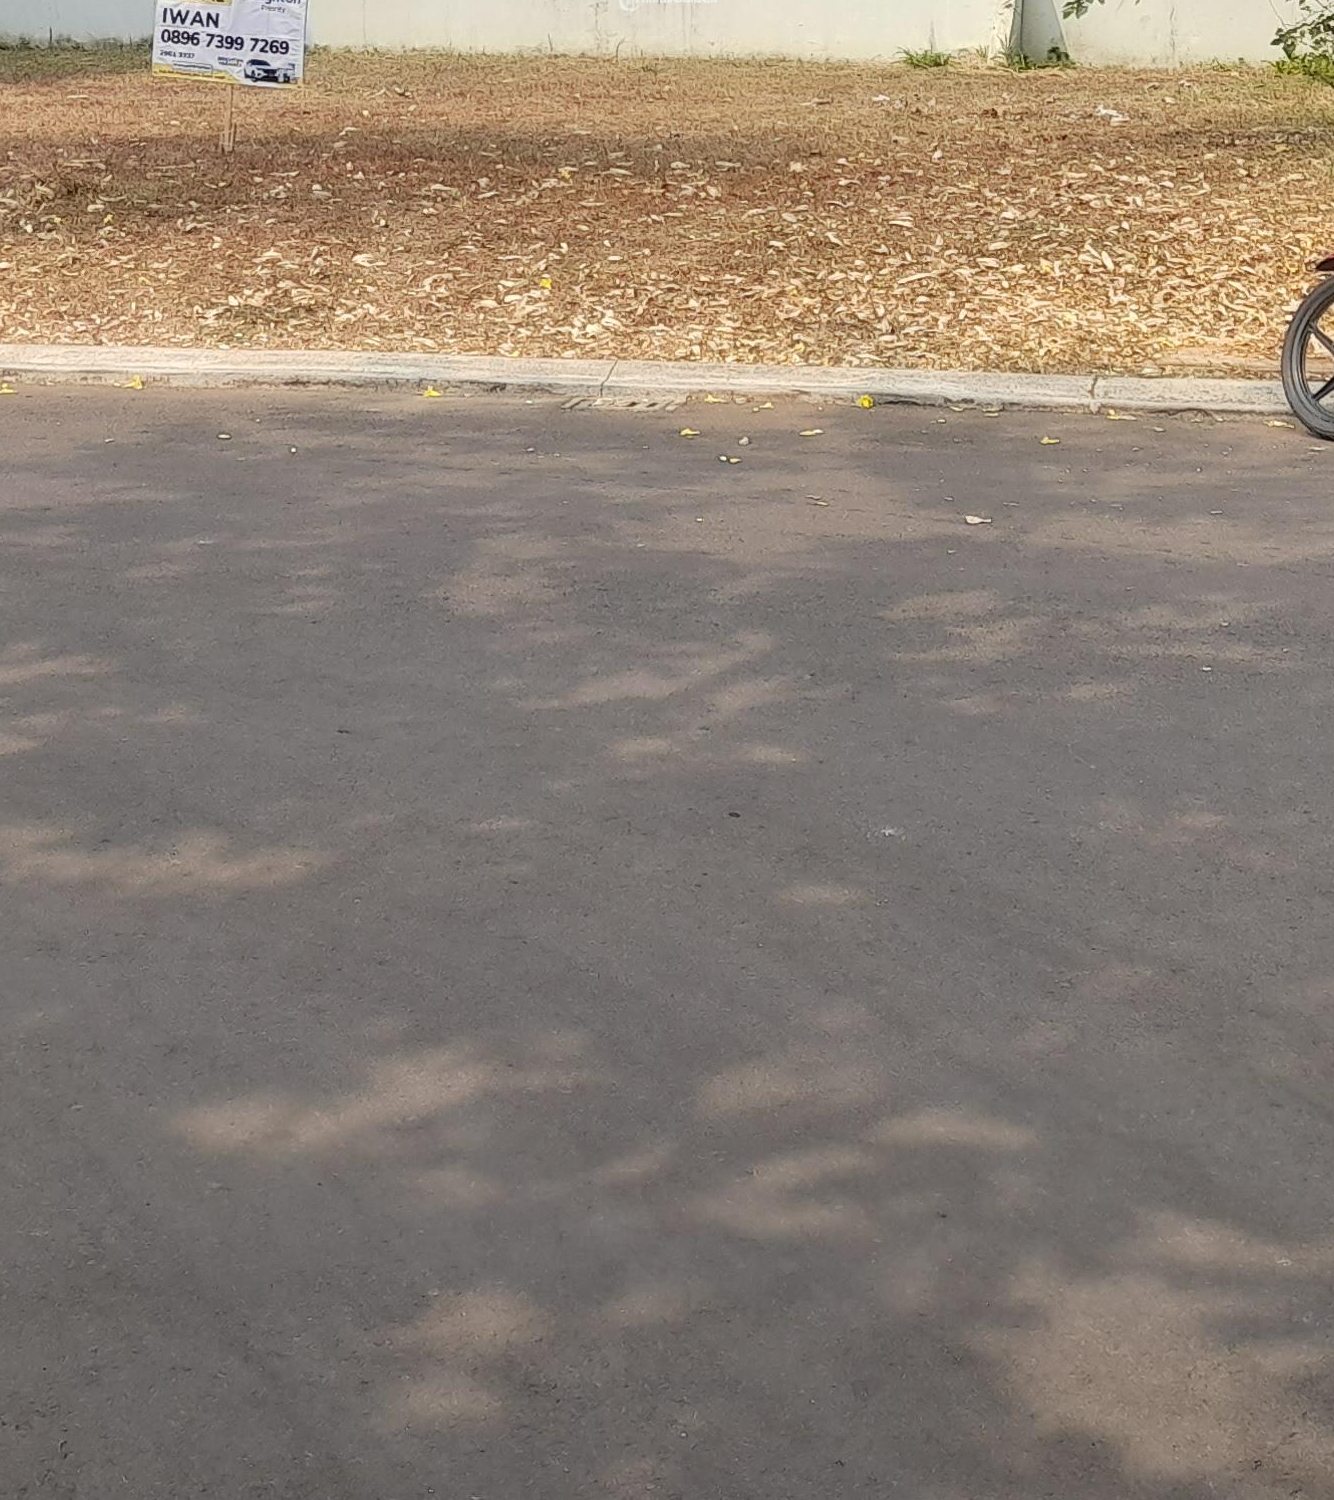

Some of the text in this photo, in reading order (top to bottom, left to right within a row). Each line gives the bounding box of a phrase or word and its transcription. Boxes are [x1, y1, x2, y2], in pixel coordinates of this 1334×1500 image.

[162, 7, 221, 29] IWAN
[160, 28, 290, 55] 0896 7399 7269
